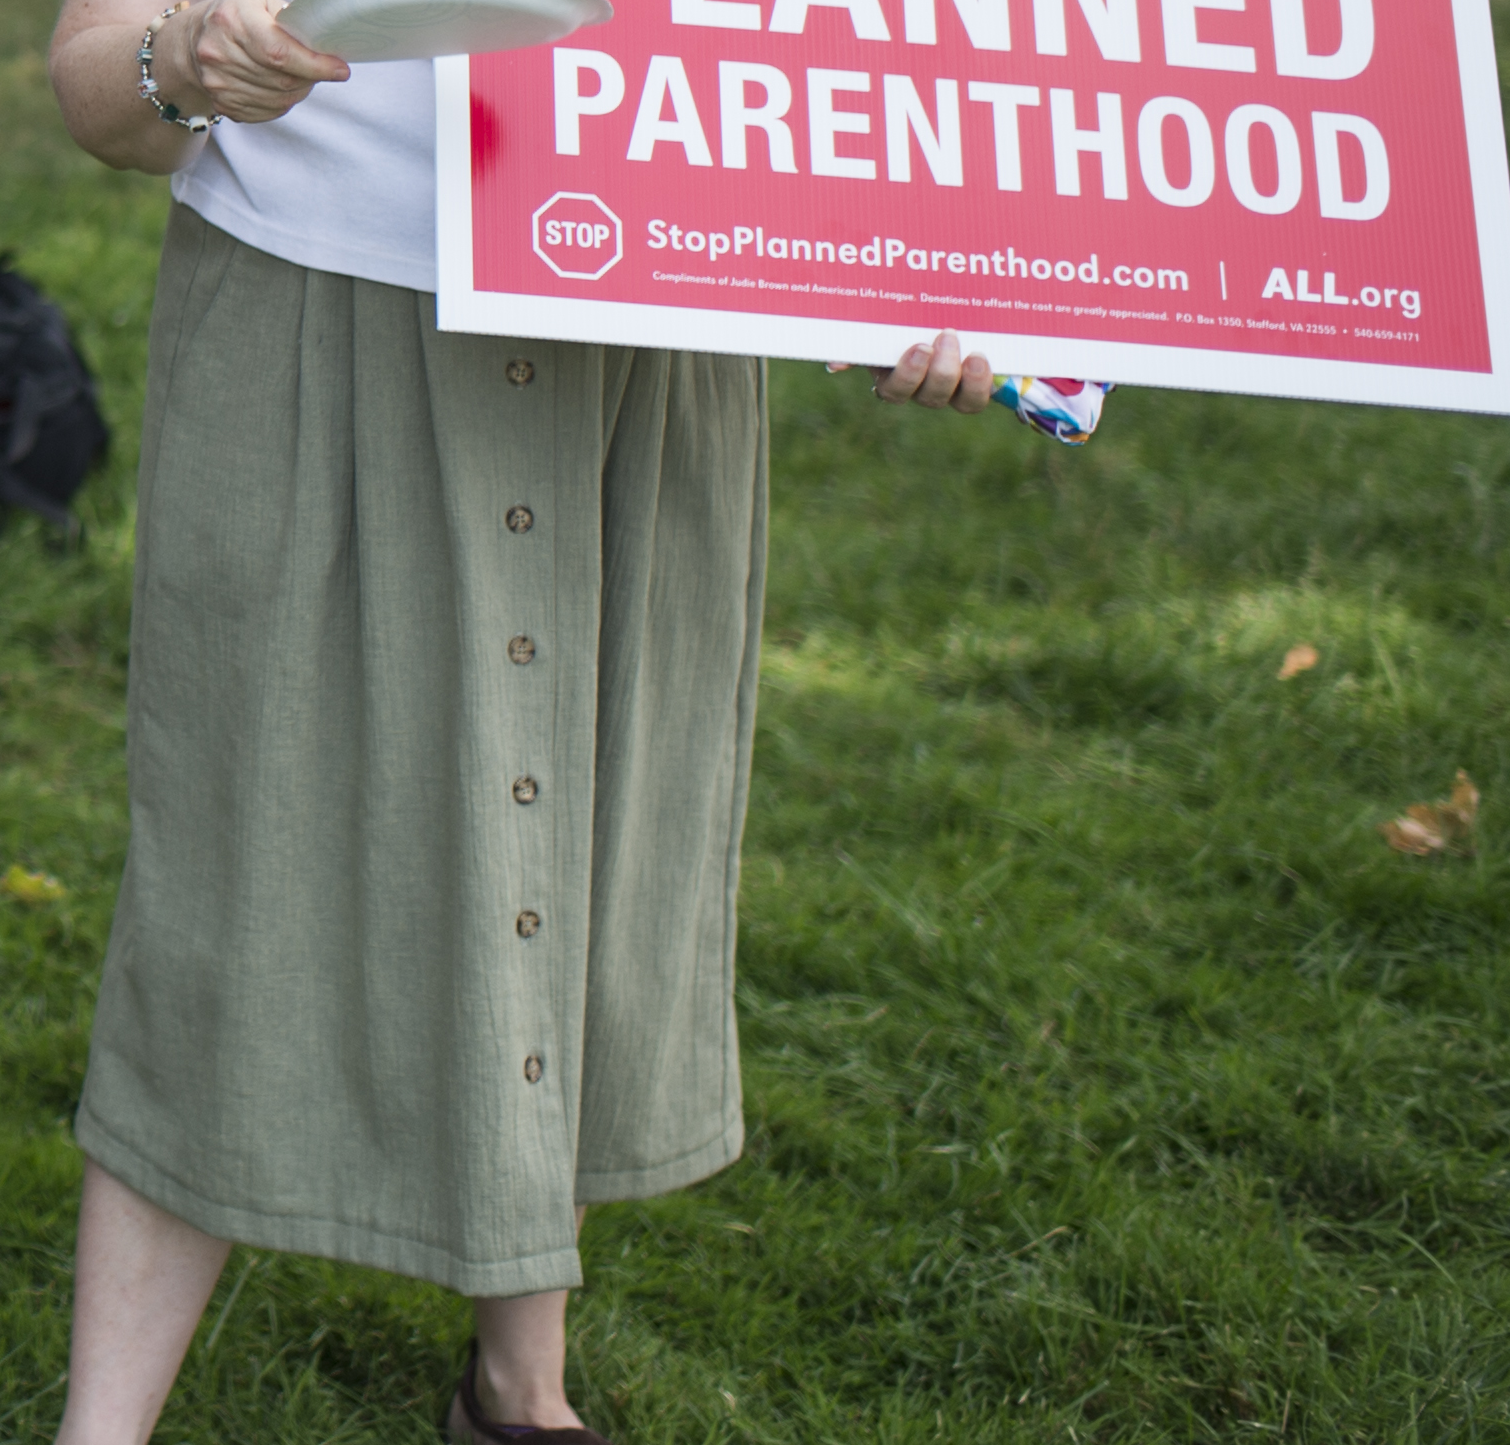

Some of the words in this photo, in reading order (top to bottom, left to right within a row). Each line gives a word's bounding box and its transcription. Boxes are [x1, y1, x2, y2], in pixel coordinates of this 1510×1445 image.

[553, 46, 1390, 220] PARENTHOOD
[545, 219, 609, 248] STOP
[647, 219, 1188, 291] StopPlannedParenthood.com
[1261, 267, 1421, 319] ALL.org
[652, 270, 716, 285] Compliments
[717, 275, 728, 285] of
[729, 276, 756, 288] Judie
[757, 278, 789, 290] Brown
[790, 282, 810, 292] and
[811, 283, 858, 296] American
[859, 287, 877, 298] Life
[919, 291, 970, 306] Donations
[971, 297, 982, 307] to
[983, 297, 1012, 309] offset
[1014, 299, 1030, 310] the
[1031, 302, 1053, 311] cost
[1054, 304, 1071, 313] are
[1072, 305, 1107, 318] greatly
[1196, 313, 1215, 324] Box
[1217, 316, 1244, 327] 1350,
[1246, 318, 1287, 331] Stafford,
[1289, 322, 1304, 332] VA
[1305, 323, 1337, 335] 22555
